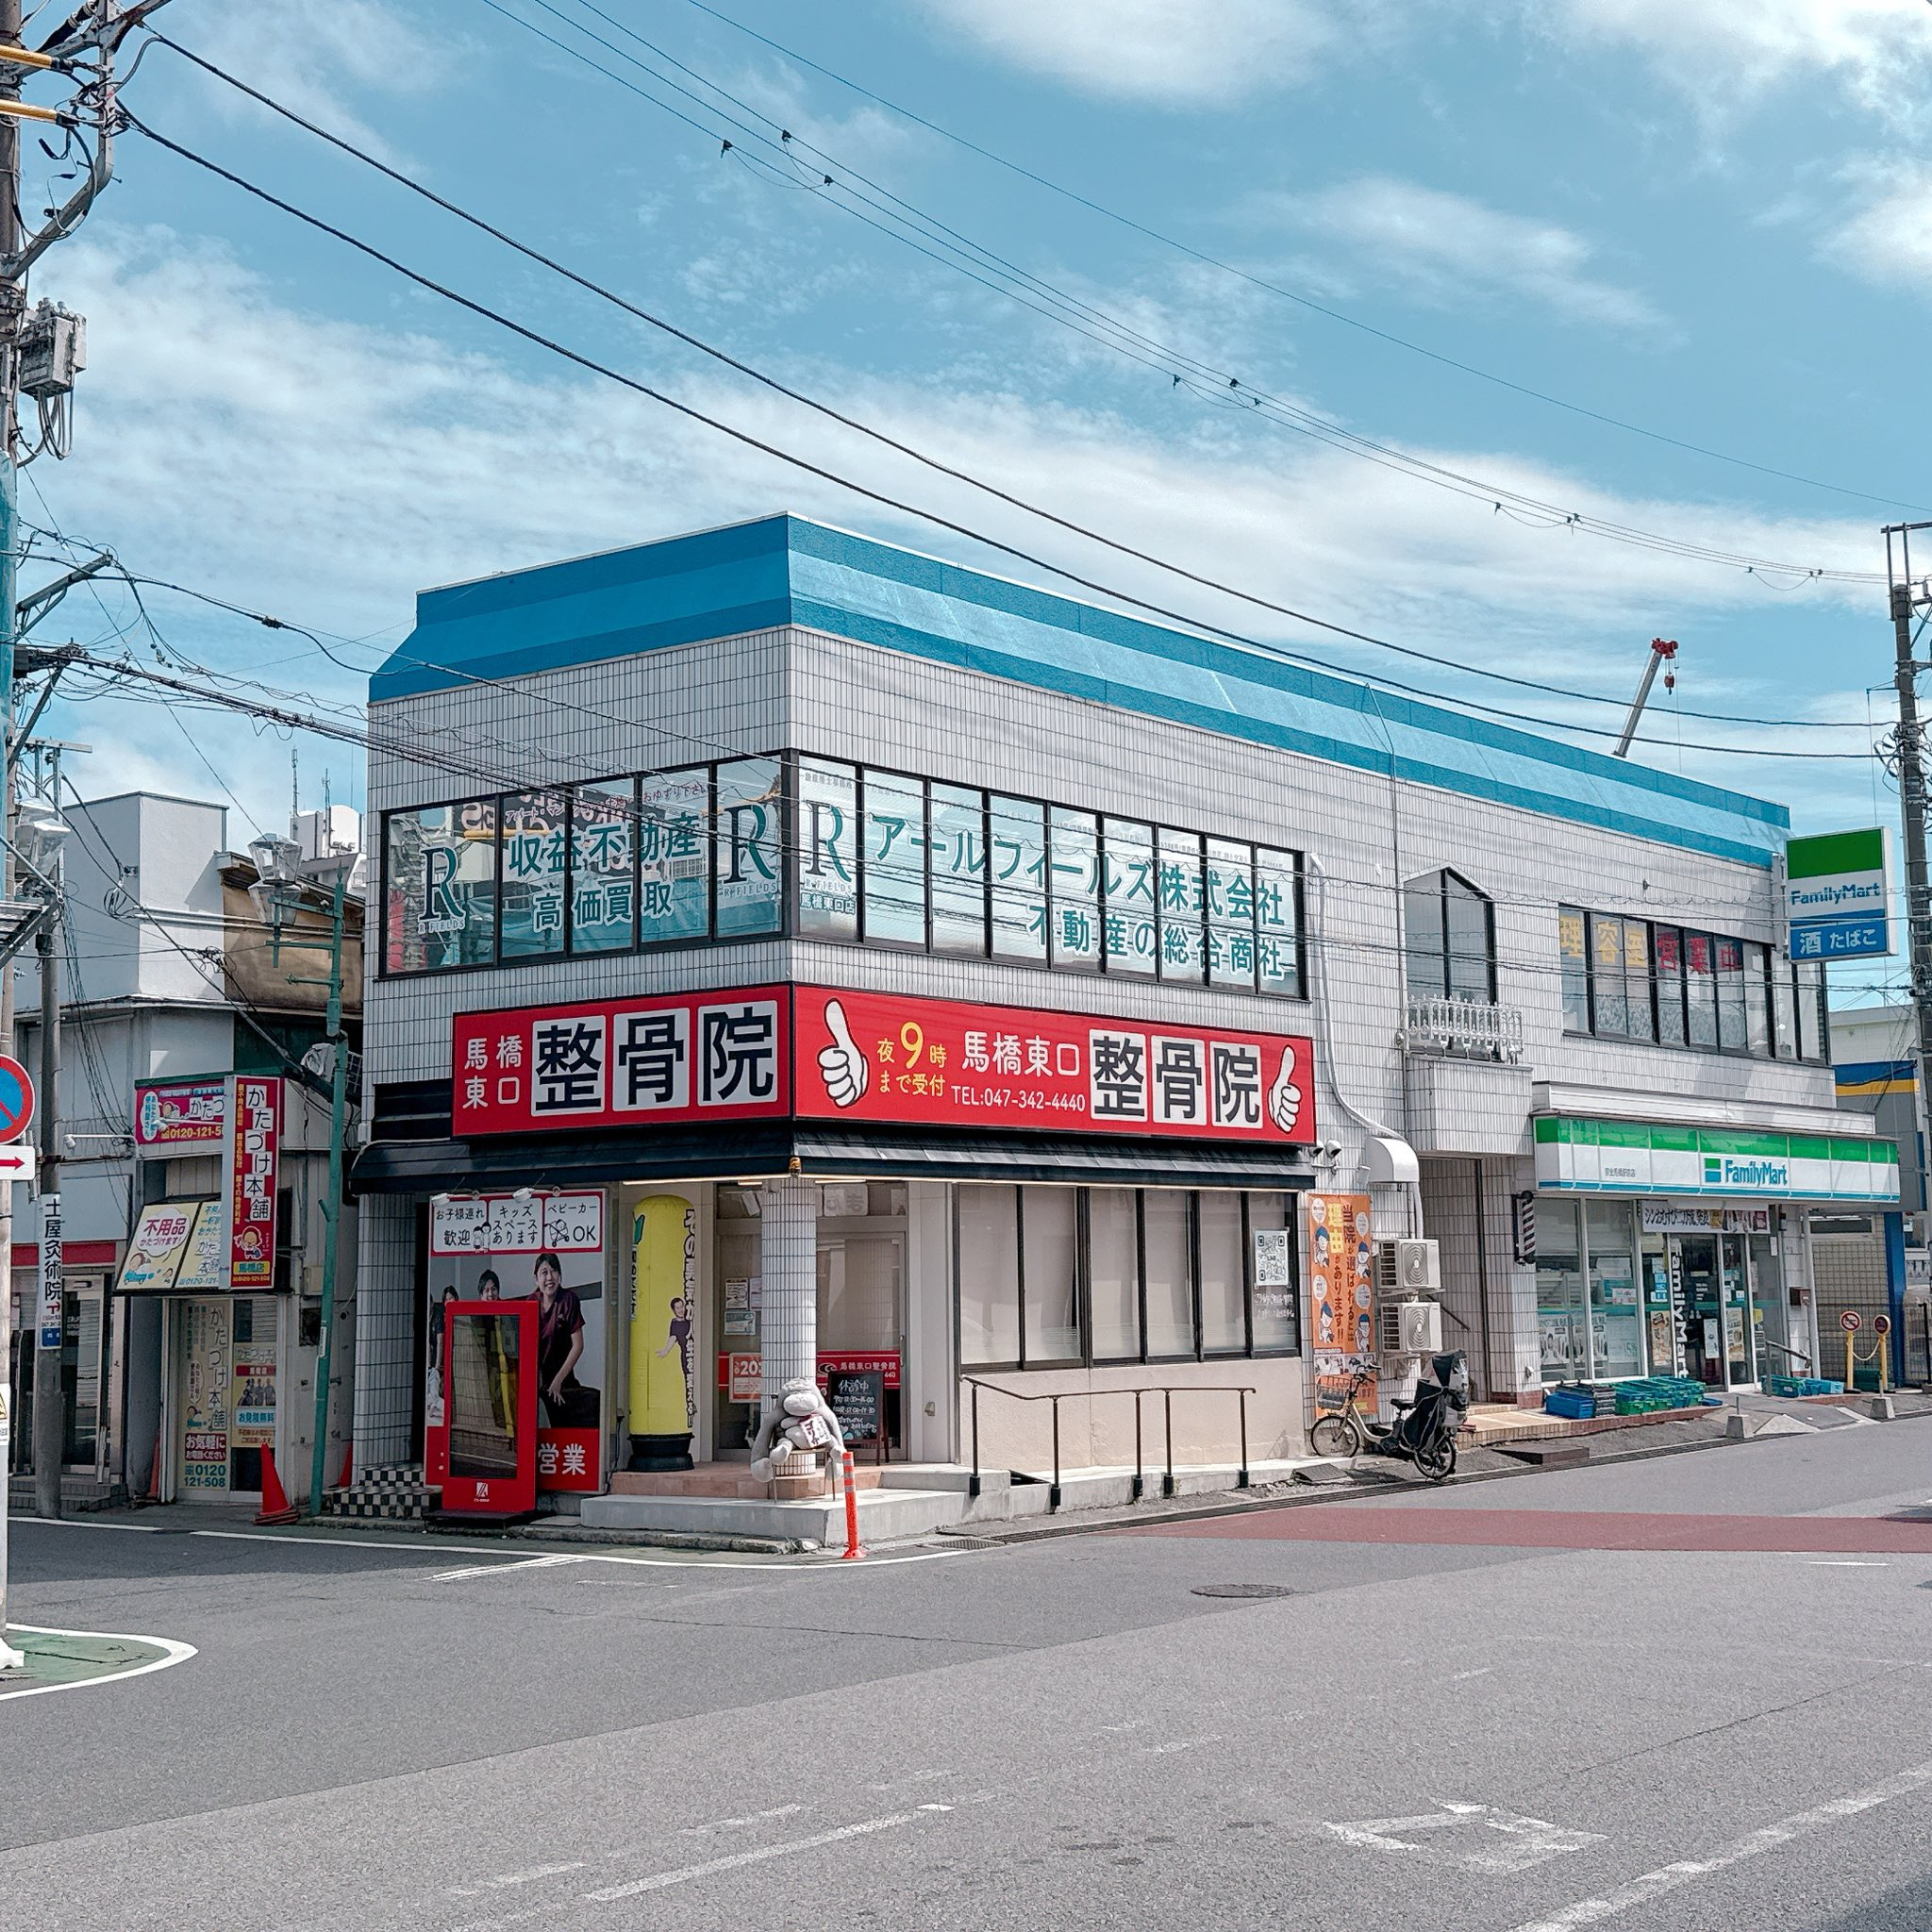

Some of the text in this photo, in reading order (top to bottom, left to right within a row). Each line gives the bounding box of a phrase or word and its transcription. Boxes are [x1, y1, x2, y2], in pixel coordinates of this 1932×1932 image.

[509, 813, 701, 875] 収益不動産
[724, 804, 776, 885] R
[806, 799, 852, 882] R
[420, 847, 465, 921] R
[871, 815, 1285, 926] アールフィールズ株式会社
[536, 882, 674, 929] 高価買取
[801, 893, 857, 915] 馬橋東口店
[1790, 882, 1881, 906] FamilyMart
[429, 919, 465, 932] FIELDS
[1029, 902, 1284, 977] 不動産の総合商社
[1799, 929, 1877, 955] 酒 たばこ
[464, 1034, 523, 1071] 馬橋
[877, 1021, 947, 1067] 夜9時
[961, 1031, 1080, 1077] 馬橋東口
[535, 1006, 774, 1112] 整骨院
[462, 1076, 520, 1109] 東口
[878, 1072, 946, 1098] まで受付
[1092, 1036, 1260, 1124] 整骨院
[951, 1084, 1086, 1113] TEL:047-342-4440
[171, 1124, 224, 1140] 0120-121-5
[246, 1087, 272, 1219] かたづけ本舗
[1724, 1158, 1788, 1187] FamilyMart
[436, 1207, 485, 1221] お子様連れ
[499, 1204, 533, 1218] キッズ
[547, 1203, 597, 1214] ベビーカー
[143, 1217, 187, 1236] 不用品
[443, 1229, 472, 1246] 歓迎
[492, 1219, 538, 1230] スペース
[492, 1229, 539, 1245] あります
[573, 1225, 597, 1242] OK
[44, 1198, 61, 1301] 土屋灸術院
[1342, 1203, 1357, 1342] 当院が選ばれるには
[1670, 1238, 1690, 1378] FamilyMart
[185, 1435, 226, 1450] お気軽に
[194, 1464, 226, 1476] 0120
[538, 1441, 586, 1476] 営業
[184, 1476, 226, 1488] 121-508
